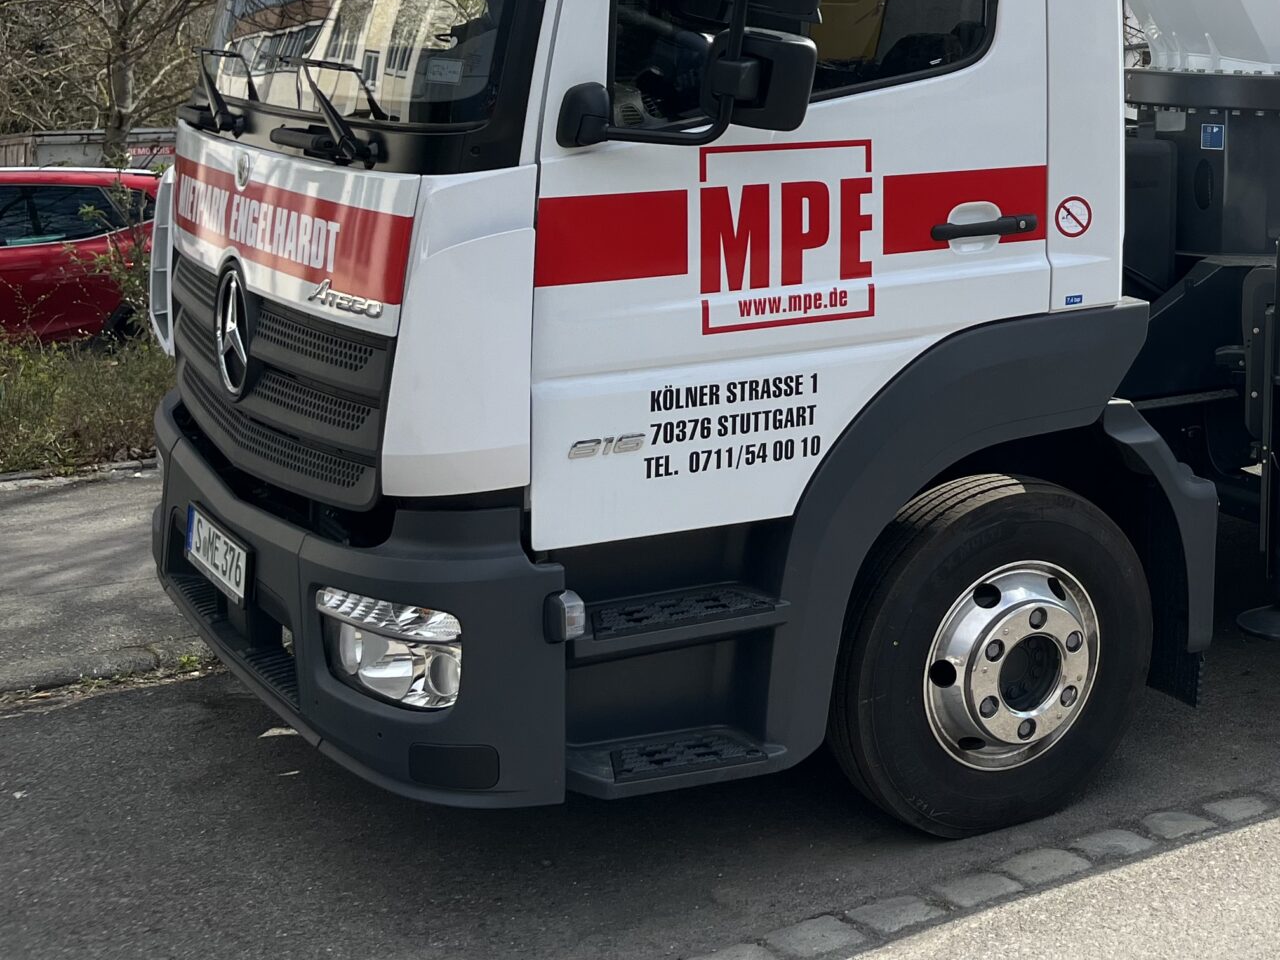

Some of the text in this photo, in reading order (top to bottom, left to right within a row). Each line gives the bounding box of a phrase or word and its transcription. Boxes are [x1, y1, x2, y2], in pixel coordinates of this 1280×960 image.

[178, 173, 341, 273] MIETPARK ENGELHARDT
[700, 177, 873, 294] MPE
[738, 287, 848, 318] www.mpe.de
[650, 373, 818, 412] KÖLNER STRASSE 1
[650, 405, 817, 445] 70376 STUTTGART
[644, 435, 821, 479] TEL. 0711/54 00 10
[222, 539, 242, 588] 376
